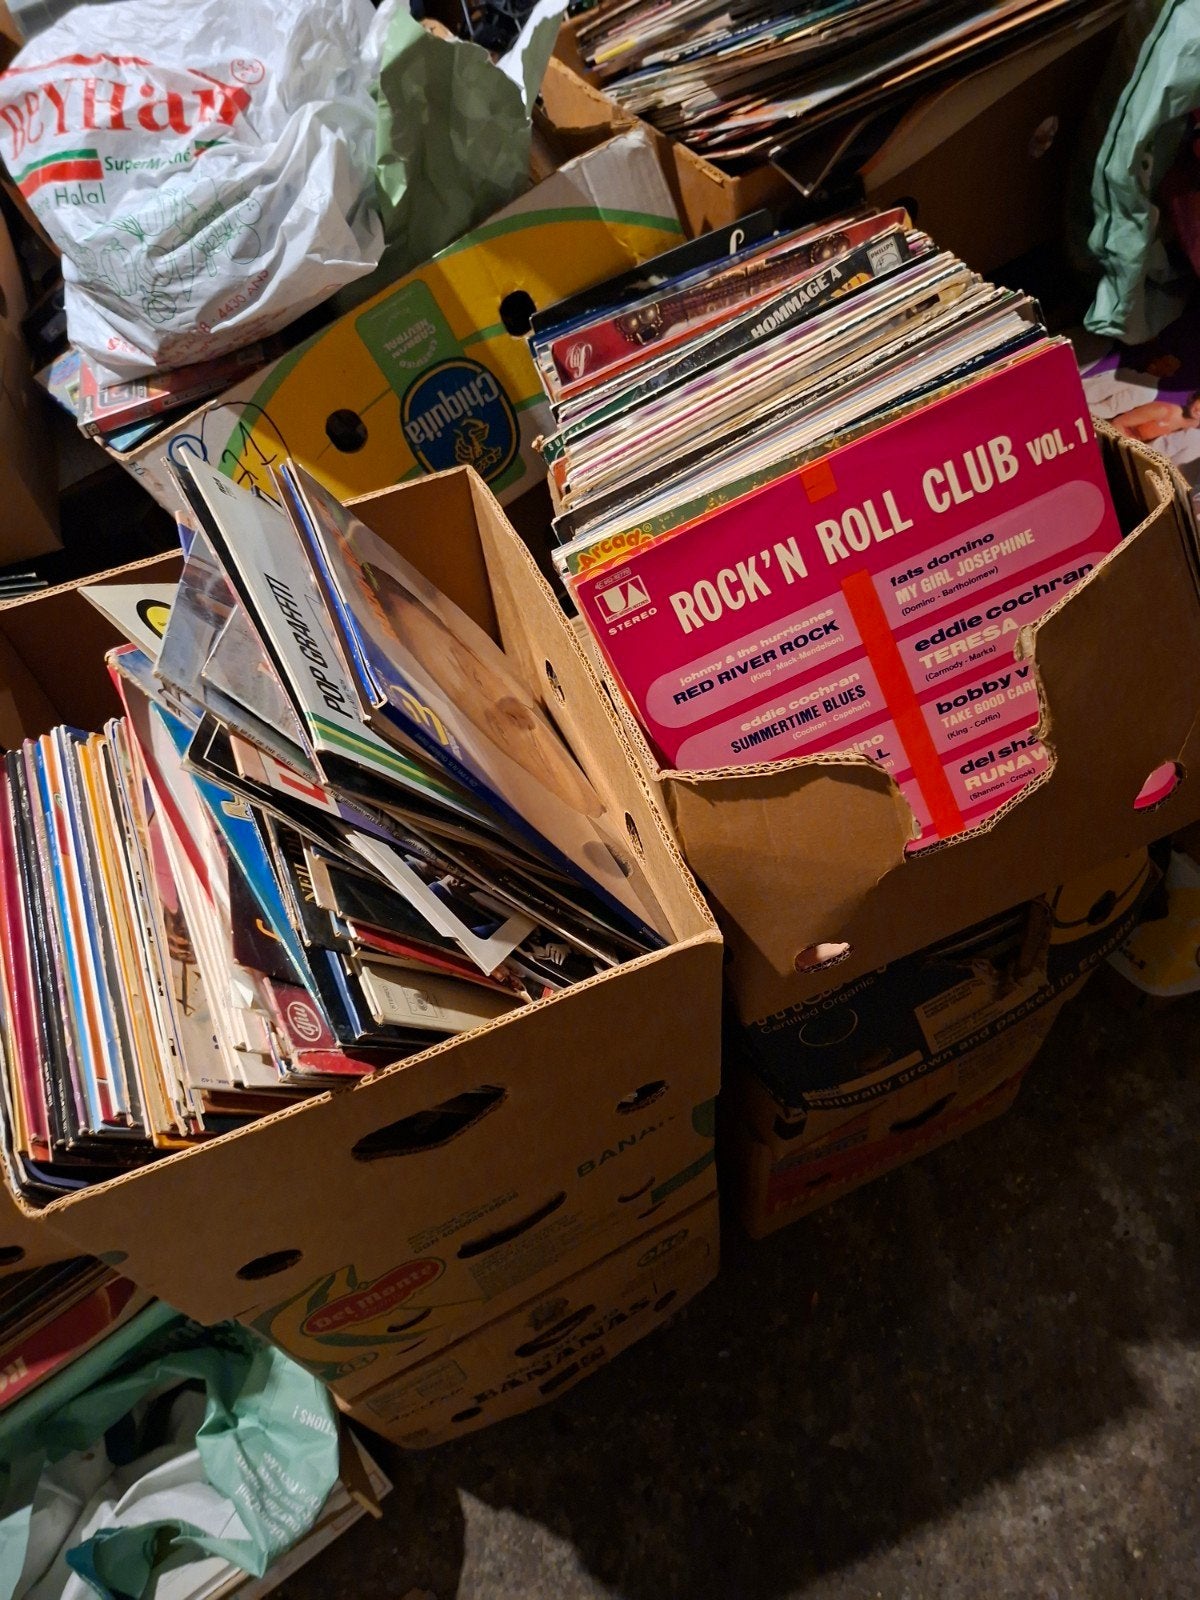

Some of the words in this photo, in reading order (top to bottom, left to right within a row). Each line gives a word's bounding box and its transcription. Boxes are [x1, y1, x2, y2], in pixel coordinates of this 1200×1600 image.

[54, 182, 106, 207] Halal
[870, 242, 895, 259] PHILIPS
[750, 275, 830, 340] HOMMAGE
[831, 269, 843, 283] A
[383, 318, 429, 351] NEUTRAL
[391, 325, 437, 361] CARBON
[404, 371, 500, 446] Chiquita
[669, 536, 809, 635] ROCK'N
[815, 490, 914, 566] ROLL
[922, 435, 1020, 514] CLUB
[1026, 432, 1075, 467] VOL.
[890, 566, 925, 587] fats
[927, 533, 994, 570] domino
[895, 584, 918, 605] MY
[921, 569, 953, 593] GIRL
[957, 529, 1035, 577] JOSEPHINE
[901, 595, 936, 616] (Domino
[942, 566, 999, 598] Bartholomew)
[264, 573, 325, 670] GRAFFITI
[608, 607, 658, 636] STEREO
[914, 614, 983, 652] eddie
[986, 563, 1094, 620] cochran
[673, 680, 715, 706] RED
[717, 650, 778, 685] RIVER
[779, 620, 840, 656] ROCK
[680, 660, 723, 687] johnny
[736, 644, 758, 659] the
[759, 608, 835, 648] hurricanes
[919, 617, 1019, 670] TERESA
[925, 660, 963, 682] (Carmody
[969, 645, 997, 662] Marks)
[312, 664, 353, 719] POP
[740, 705, 787, 732] eddie
[789, 672, 860, 711] cochran
[750, 670, 772, 684] (King
[936, 673, 1011, 715] bobby
[731, 705, 822, 754] SUMMERTIME
[823, 684, 866, 714] BLUES
[792, 720, 828, 741] (Cochran
[832, 700, 871, 723] Capehart)
[941, 708, 973, 728] TAKE
[974, 693, 1005, 715] GOOD
[947, 725, 969, 740] (King
[974, 712, 1001, 728] Coffin)
[960, 751, 996, 775] del
[998, 735, 1039, 760] sha
[964, 746, 1048, 791] RUNAW
[969, 781, 1005, 801] (Shannon
[1010, 767, 1036, 783] Crook)
[760, 1006, 819, 1035] Certified
[821, 977, 876, 1010] Organic
[808, 1079, 893, 1108] Naturally
[898, 1050, 954, 1084] grown
[958, 1027, 990, 1051] and
[994, 983, 1056, 1032] packed
[1058, 970, 1076, 987] in
[315, 1307, 356, 1329] Del
[357, 1263, 433, 1308] Monte
